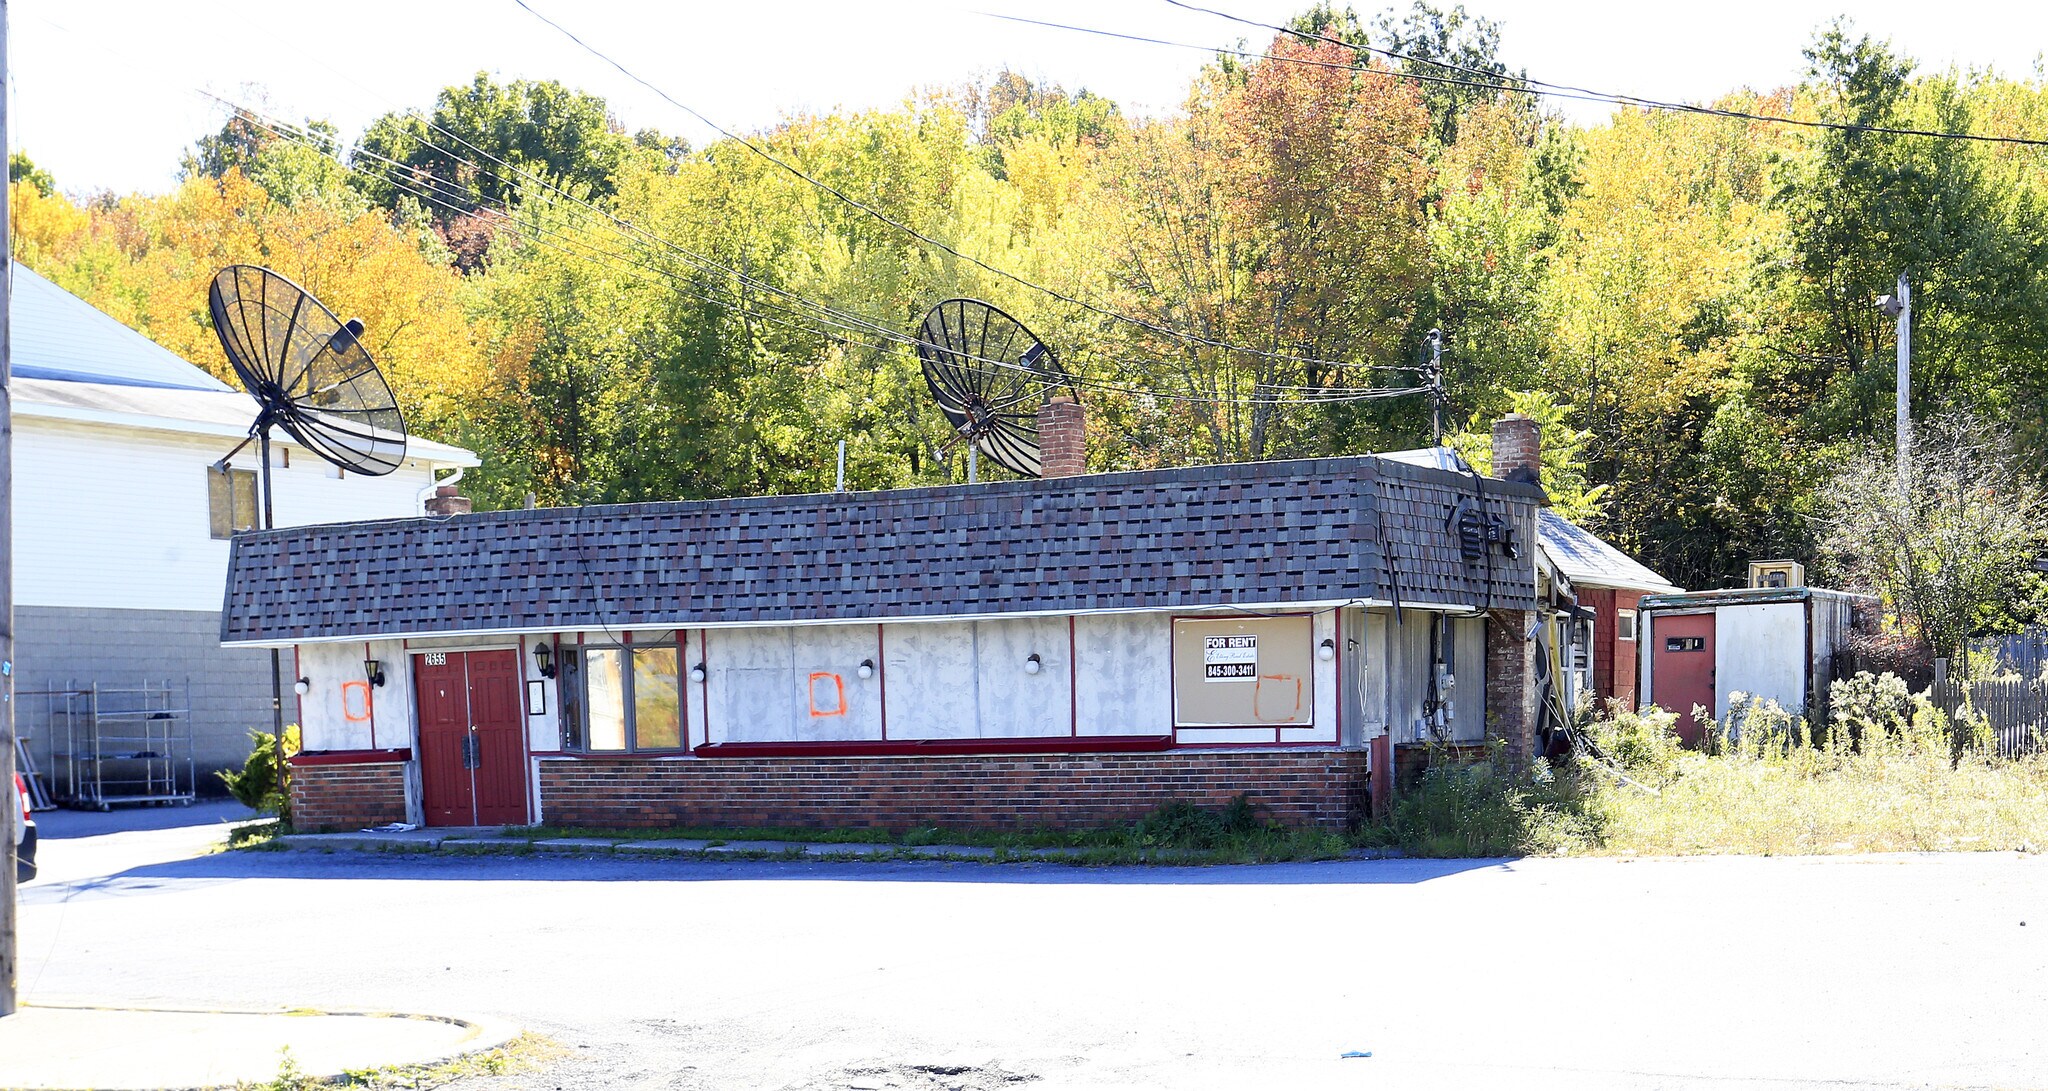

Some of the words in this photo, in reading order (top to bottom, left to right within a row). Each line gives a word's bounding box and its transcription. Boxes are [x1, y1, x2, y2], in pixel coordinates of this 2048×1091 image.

[1206, 638, 1225, 648] FOR
[1228, 638, 1255, 647] RENT
[426, 653, 445, 665] 2655
[1208, 665, 1253, 676] 845-300-3411
